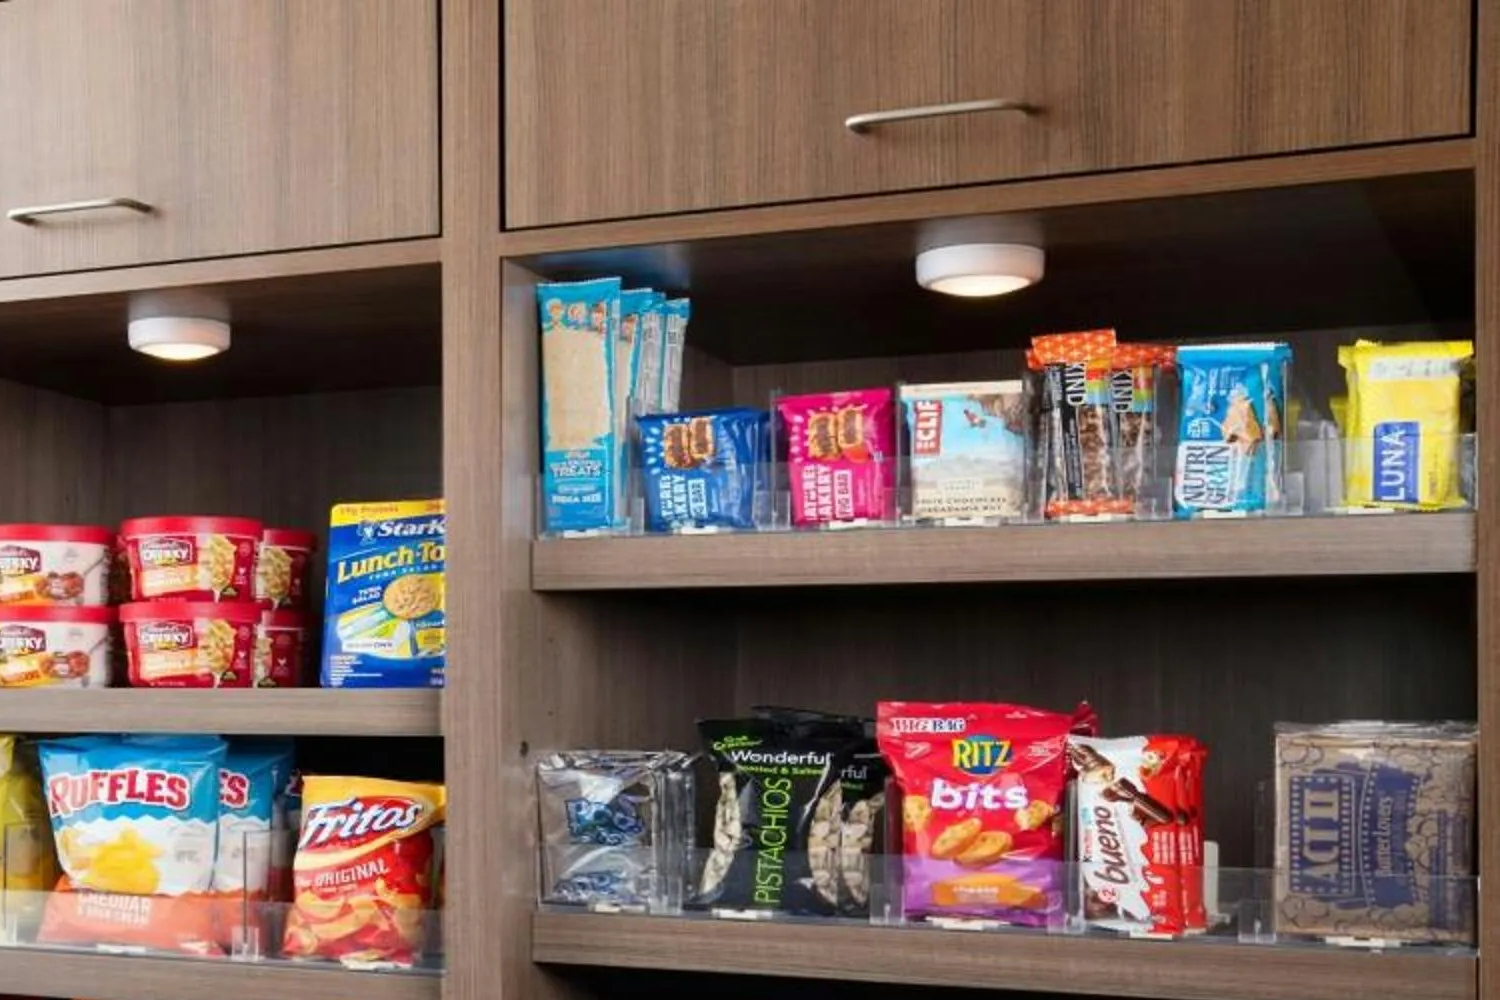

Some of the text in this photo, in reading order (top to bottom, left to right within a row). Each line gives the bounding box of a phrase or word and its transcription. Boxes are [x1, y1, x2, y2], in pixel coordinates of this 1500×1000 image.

[1065, 361, 1086, 406] KIND
[1183, 444, 1206, 502] NUTRI
[1206, 445, 1230, 506] GRAIN
[1380, 428, 1406, 501] LUNA
[731, 749, 831, 765] Wonderful
[951, 738, 1012, 769] RITZ
[49, 769, 190, 815] RUFFLES
[930, 777, 1029, 809] bits
[299, 798, 423, 850] Fritos
[754, 777, 792, 904] PISTACHIOS
[1094, 806, 1130, 885] bueno
[314, 858, 390, 887] ORIGINAL
[1302, 824, 1340, 882] ACT
